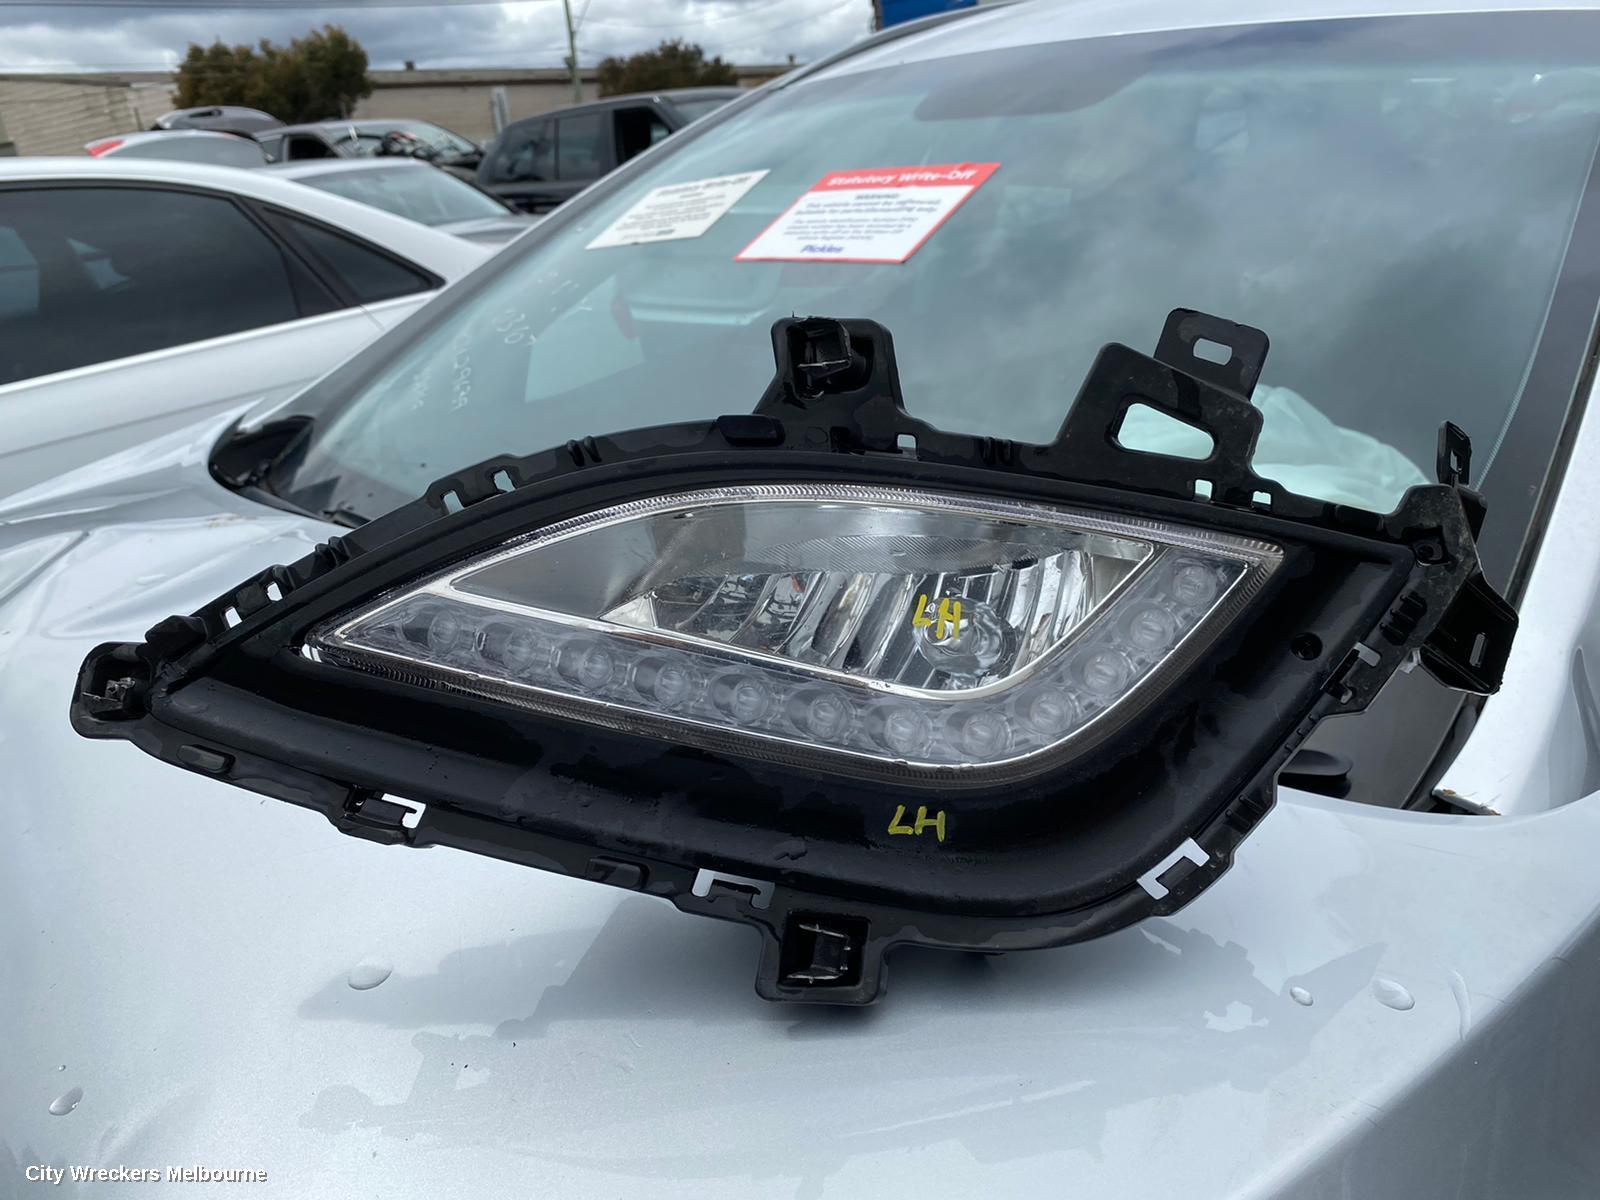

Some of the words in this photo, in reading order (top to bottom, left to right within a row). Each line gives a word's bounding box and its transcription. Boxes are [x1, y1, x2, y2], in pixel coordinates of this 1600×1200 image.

[828, 173, 896, 187] Statutory
[897, 168, 978, 182] Write-Off
[912, 593, 962, 641] LH
[887, 804, 946, 842] LH
